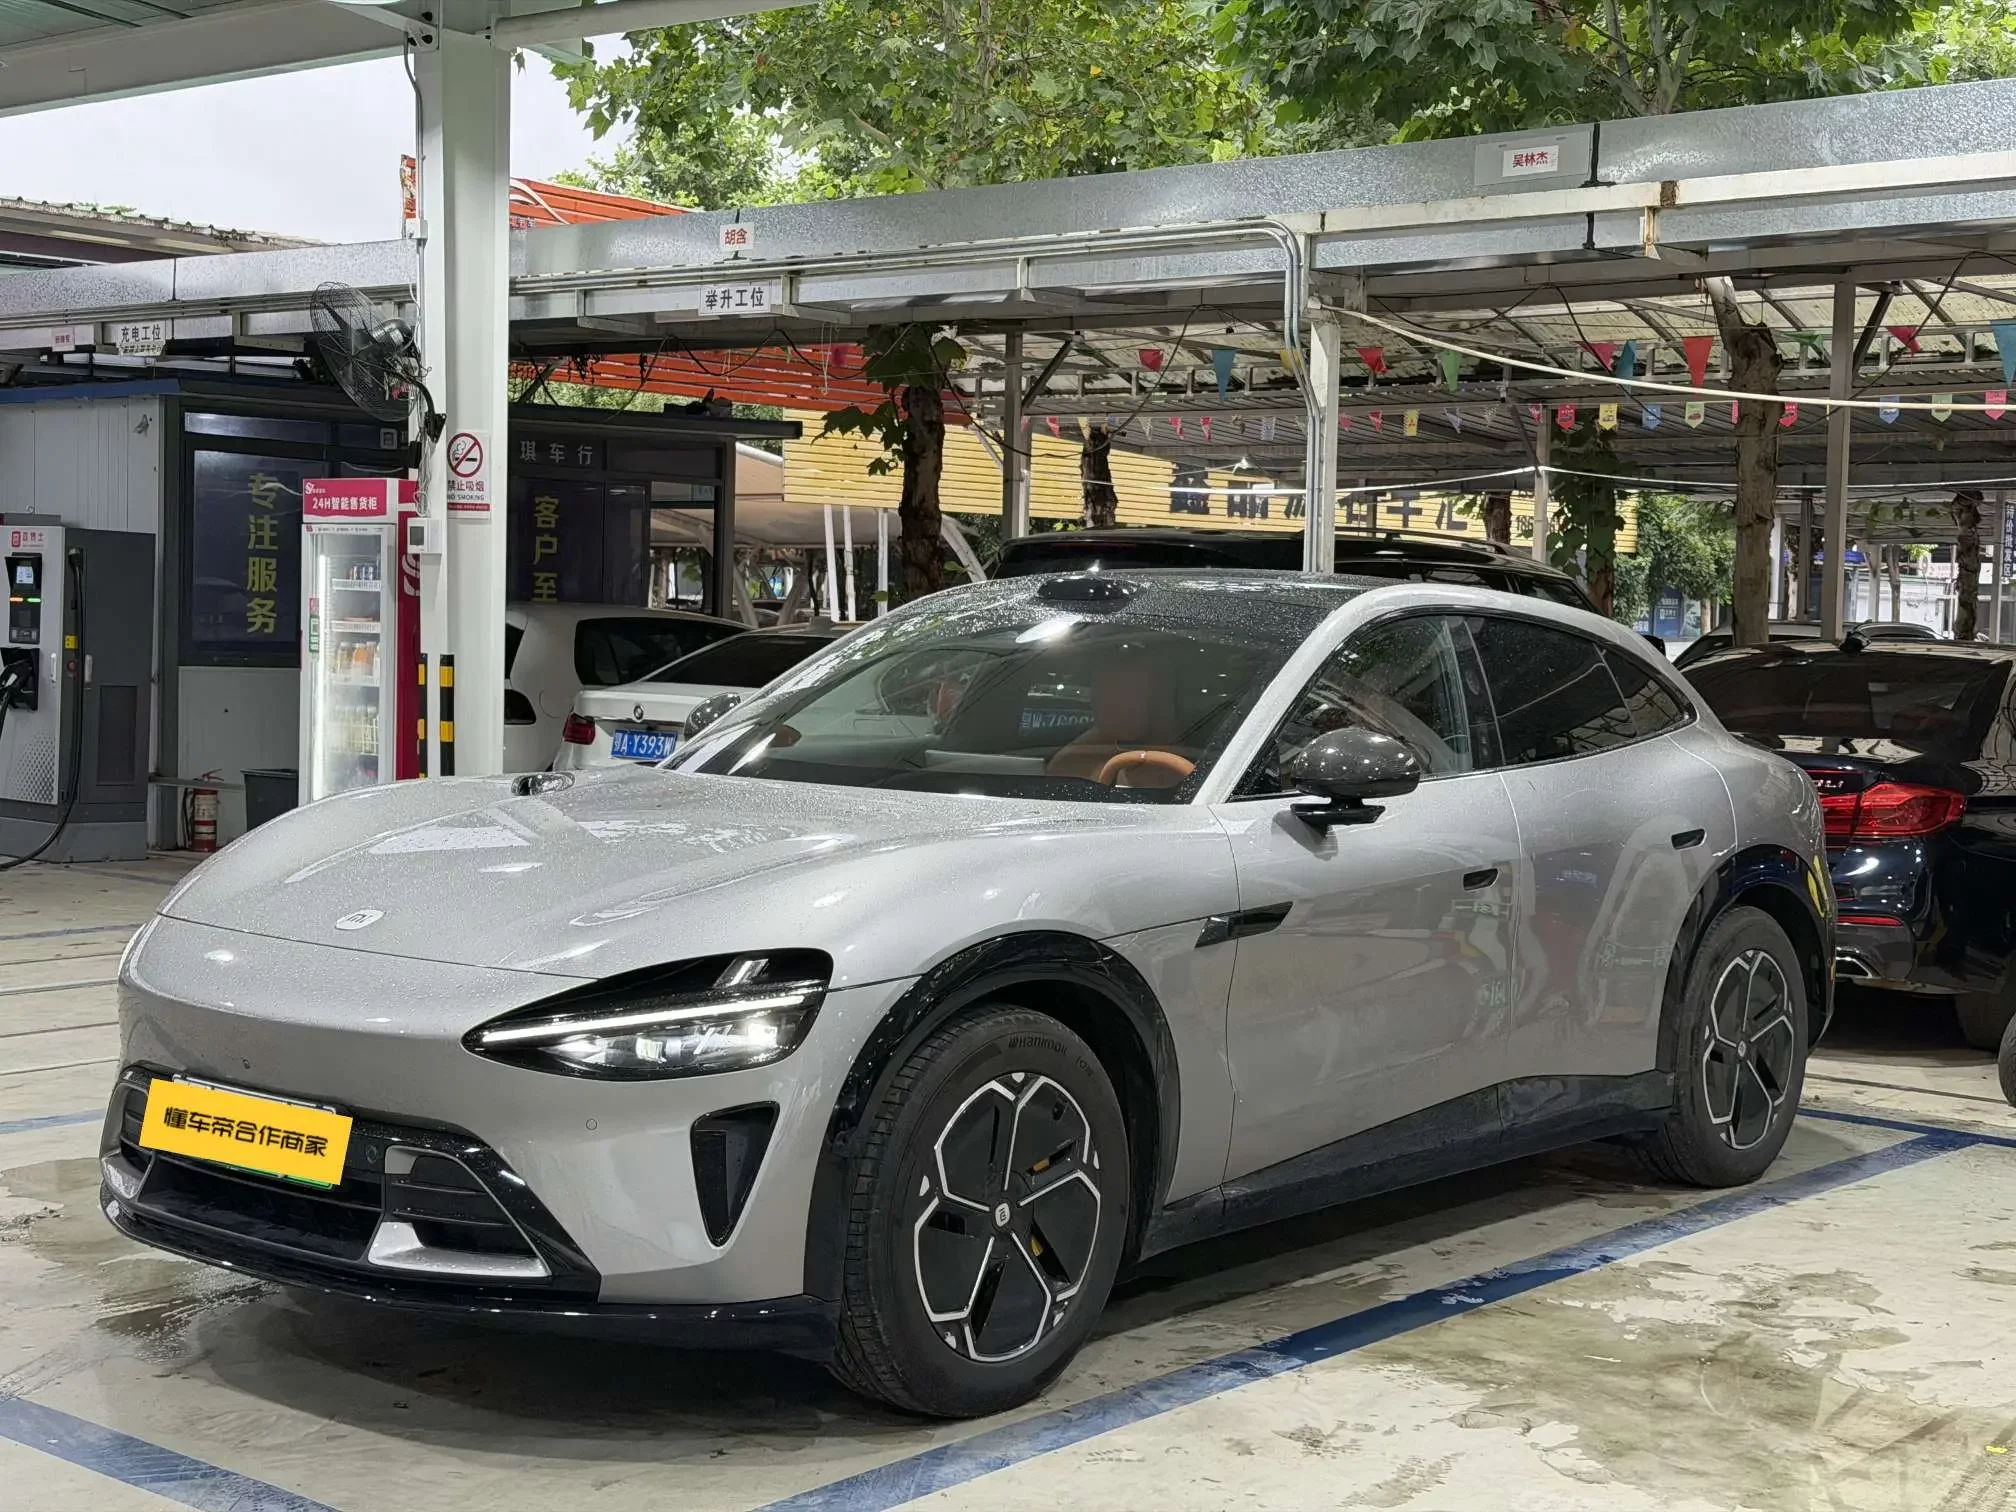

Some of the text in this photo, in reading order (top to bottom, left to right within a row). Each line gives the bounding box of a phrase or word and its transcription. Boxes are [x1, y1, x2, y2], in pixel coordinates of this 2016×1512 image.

[705, 286, 765, 310] 举升工位
[121, 323, 162, 343] 充电工位
[447, 480, 485, 492] 禁止吸烟
[312, 496, 378, 510] 24H智能售货柜
[246, 472, 279, 634] 专注服务
